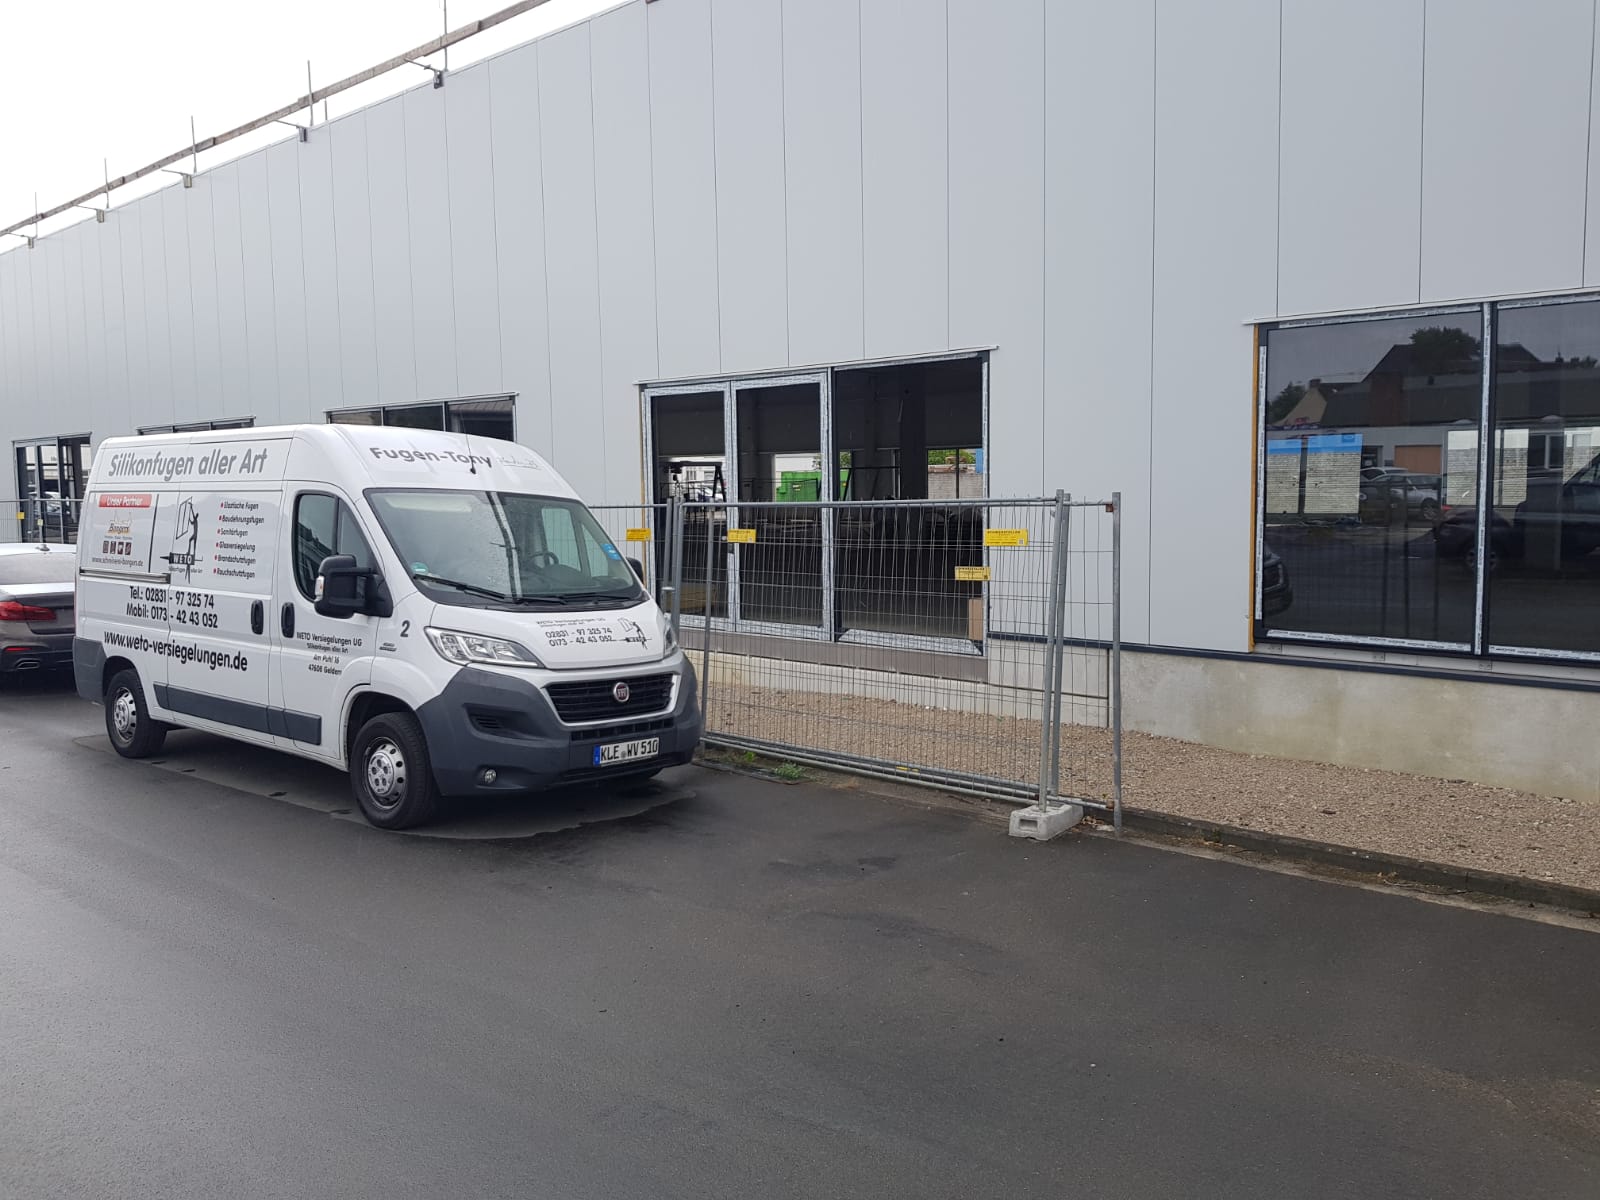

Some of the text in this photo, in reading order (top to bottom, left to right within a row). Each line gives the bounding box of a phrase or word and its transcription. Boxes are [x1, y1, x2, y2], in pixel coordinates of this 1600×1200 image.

[108, 448, 268, 482] Silikonfugen aller Art
[369, 447, 493, 468] Fugen-Tony
[245, 502, 259, 511] Fugen
[173, 554, 193, 564] WETO
[129, 585, 144, 600] Tel.:
[145, 587, 167, 603] 02831
[175, 590, 185, 606] 97
[187, 592, 201, 608] 325
[204, 594, 215, 609] 74
[126, 602, 149, 618] Mobil:
[150, 605, 168, 621] 0173
[176, 609, 187, 624] 42
[189, 611, 200, 626] 43
[202, 612, 218, 629] 052
[399, 619, 411, 638] 2
[545, 630, 569, 639] 02831
[576, 628, 586, 636] 97
[311, 633, 352, 647] Versiegelungen
[353, 637, 363, 647] UG
[549, 639, 568, 647] 0173
[575, 636, 587, 644] 42
[103, 630, 248, 672] www.weto-versiegelungen.de
[601, 740, 659, 760] KLE WV 510
